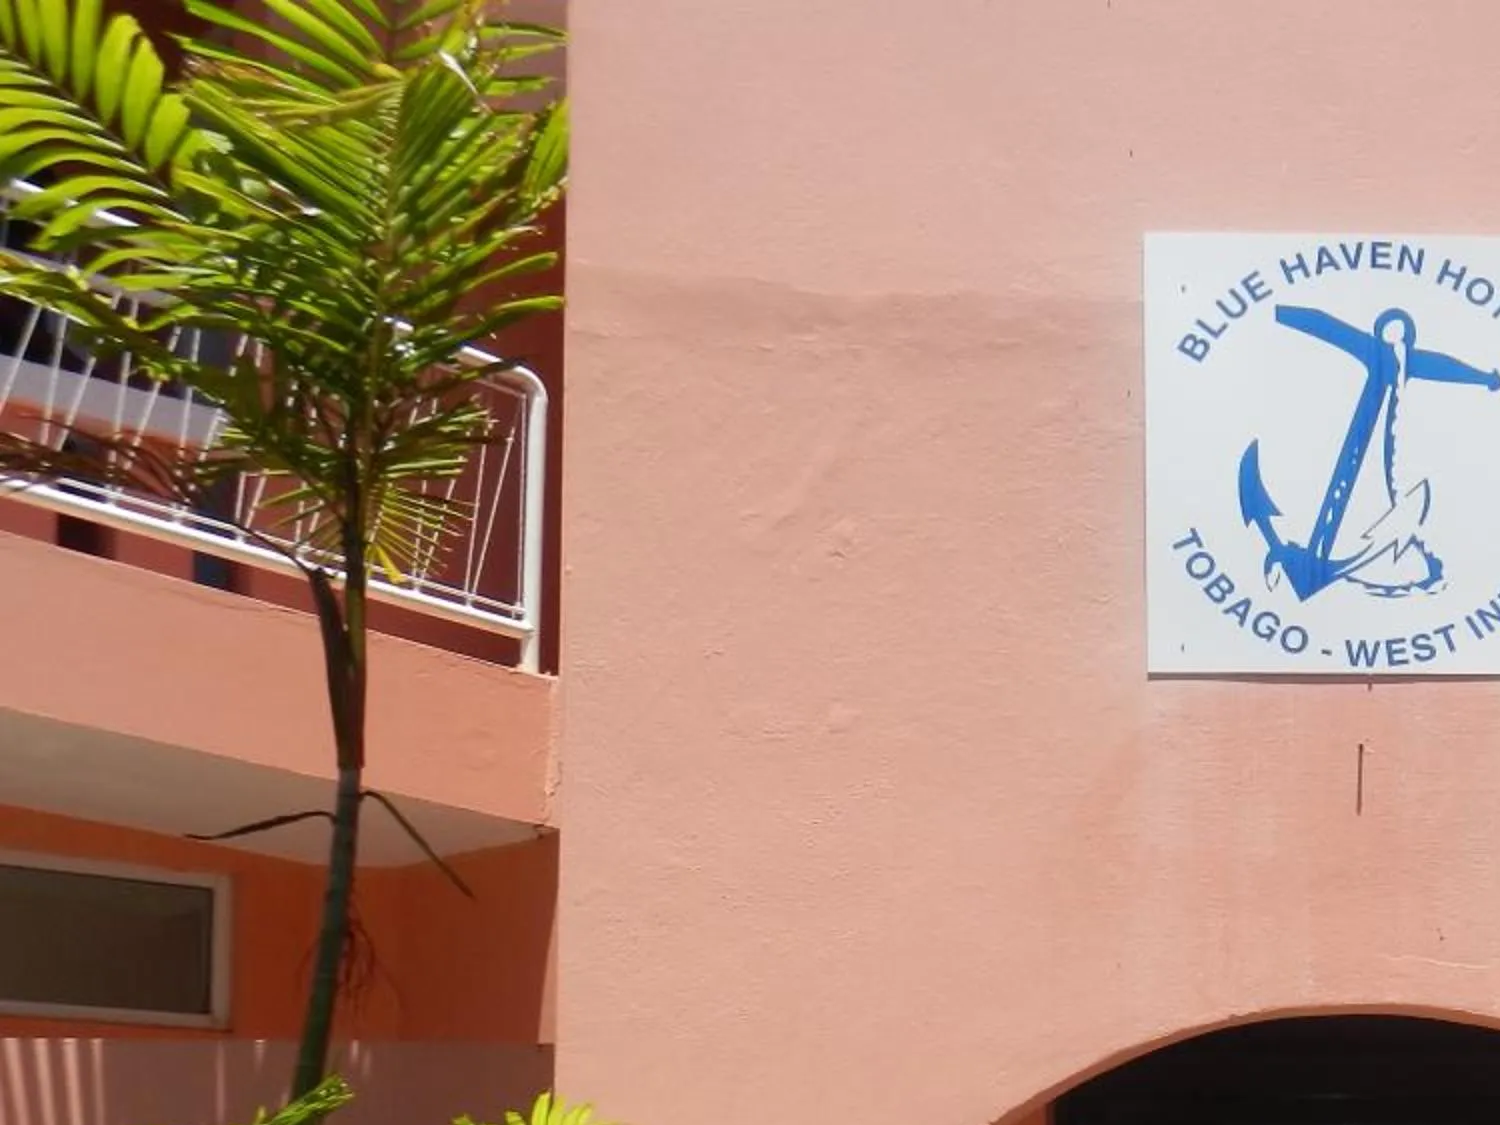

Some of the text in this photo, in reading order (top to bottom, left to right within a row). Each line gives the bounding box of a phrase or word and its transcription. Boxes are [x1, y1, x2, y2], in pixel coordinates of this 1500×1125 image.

[1176, 270, 1274, 364] BLUE
[1279, 240, 1426, 286] HAVEN
[1171, 526, 1310, 656] TOBAGO
[1344, 623, 1459, 669] WEST
